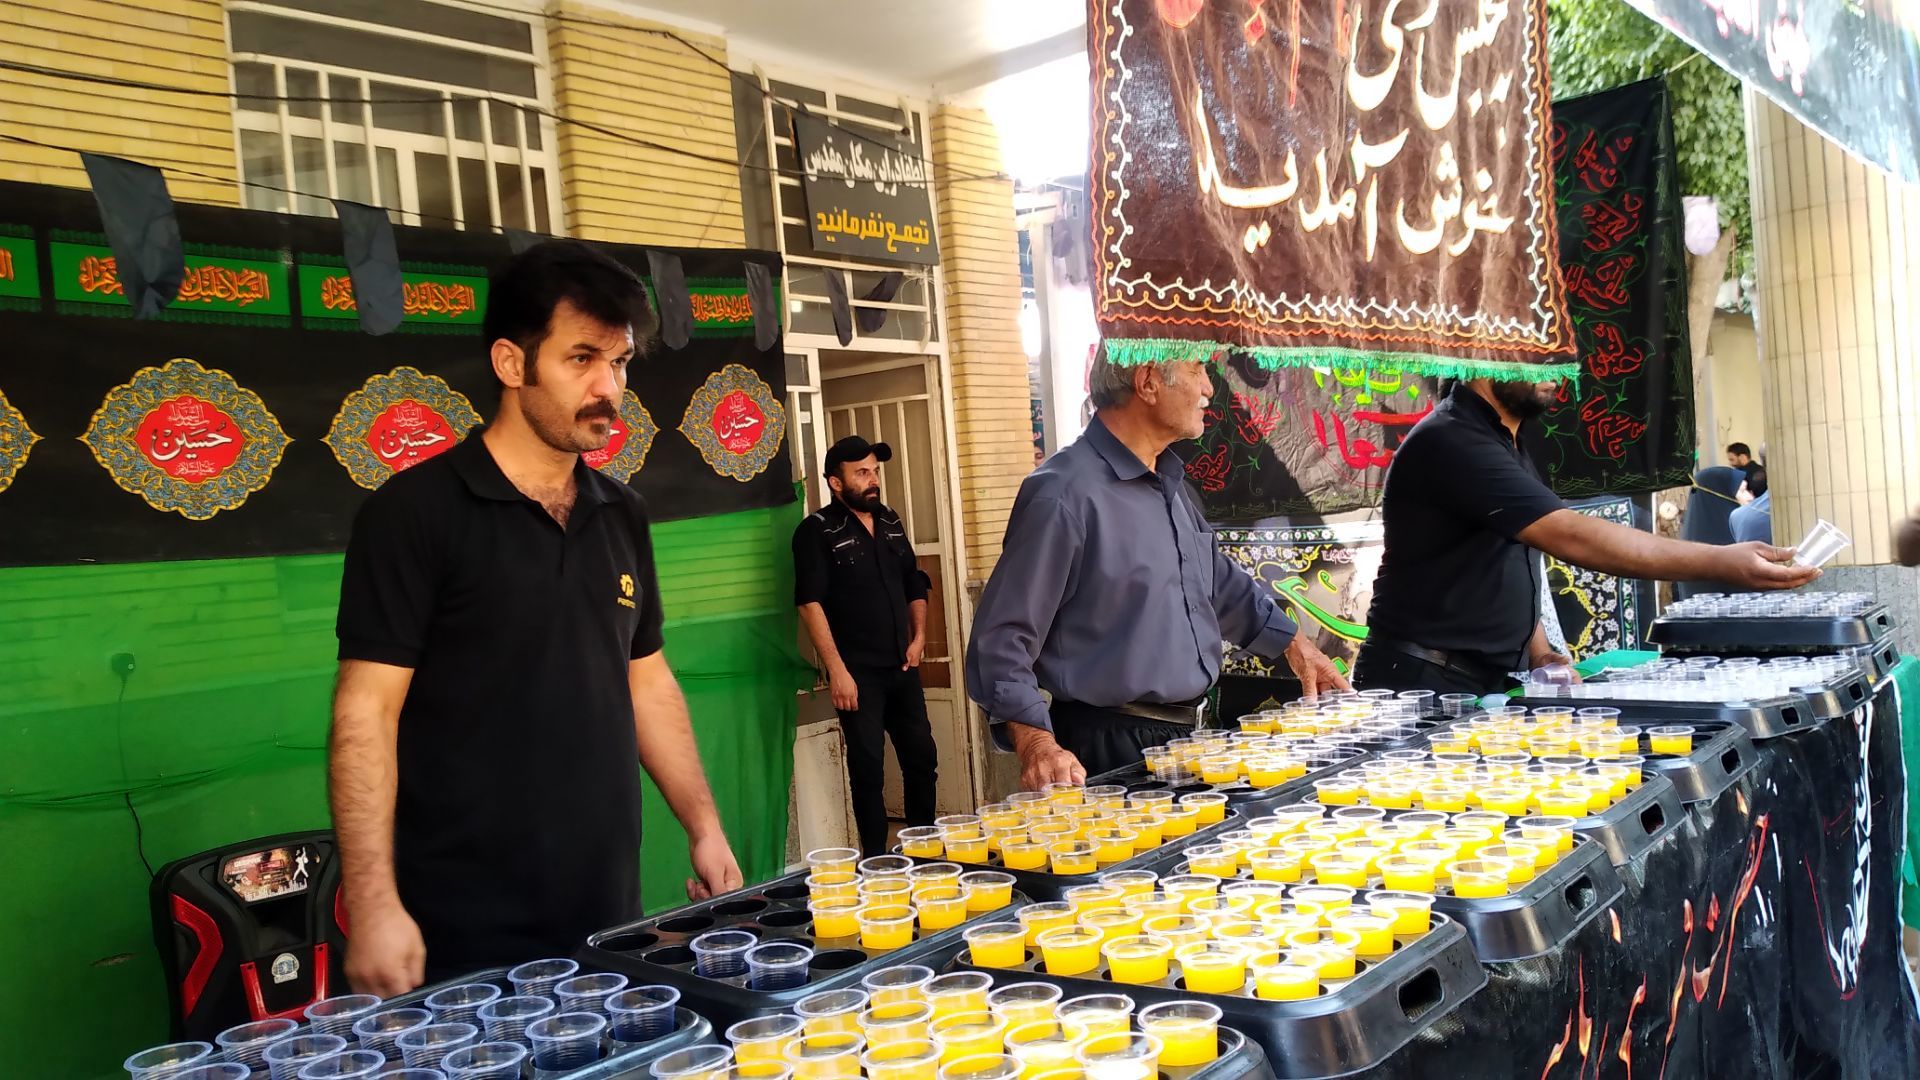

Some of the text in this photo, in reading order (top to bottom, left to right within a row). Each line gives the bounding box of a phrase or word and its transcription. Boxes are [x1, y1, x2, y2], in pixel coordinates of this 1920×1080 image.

[804, 135, 845, 182] مقدس
[844, 140, 874, 189] مکان
[1196, 84, 1410, 263] آمدید
[1396, 139, 1515, 257] خوش
[886, 218, 930, 253] تجمع
[151, 424, 234, 461] حسین
[380, 424, 447, 460] حسین
[719, 410, 760, 440] حسین
